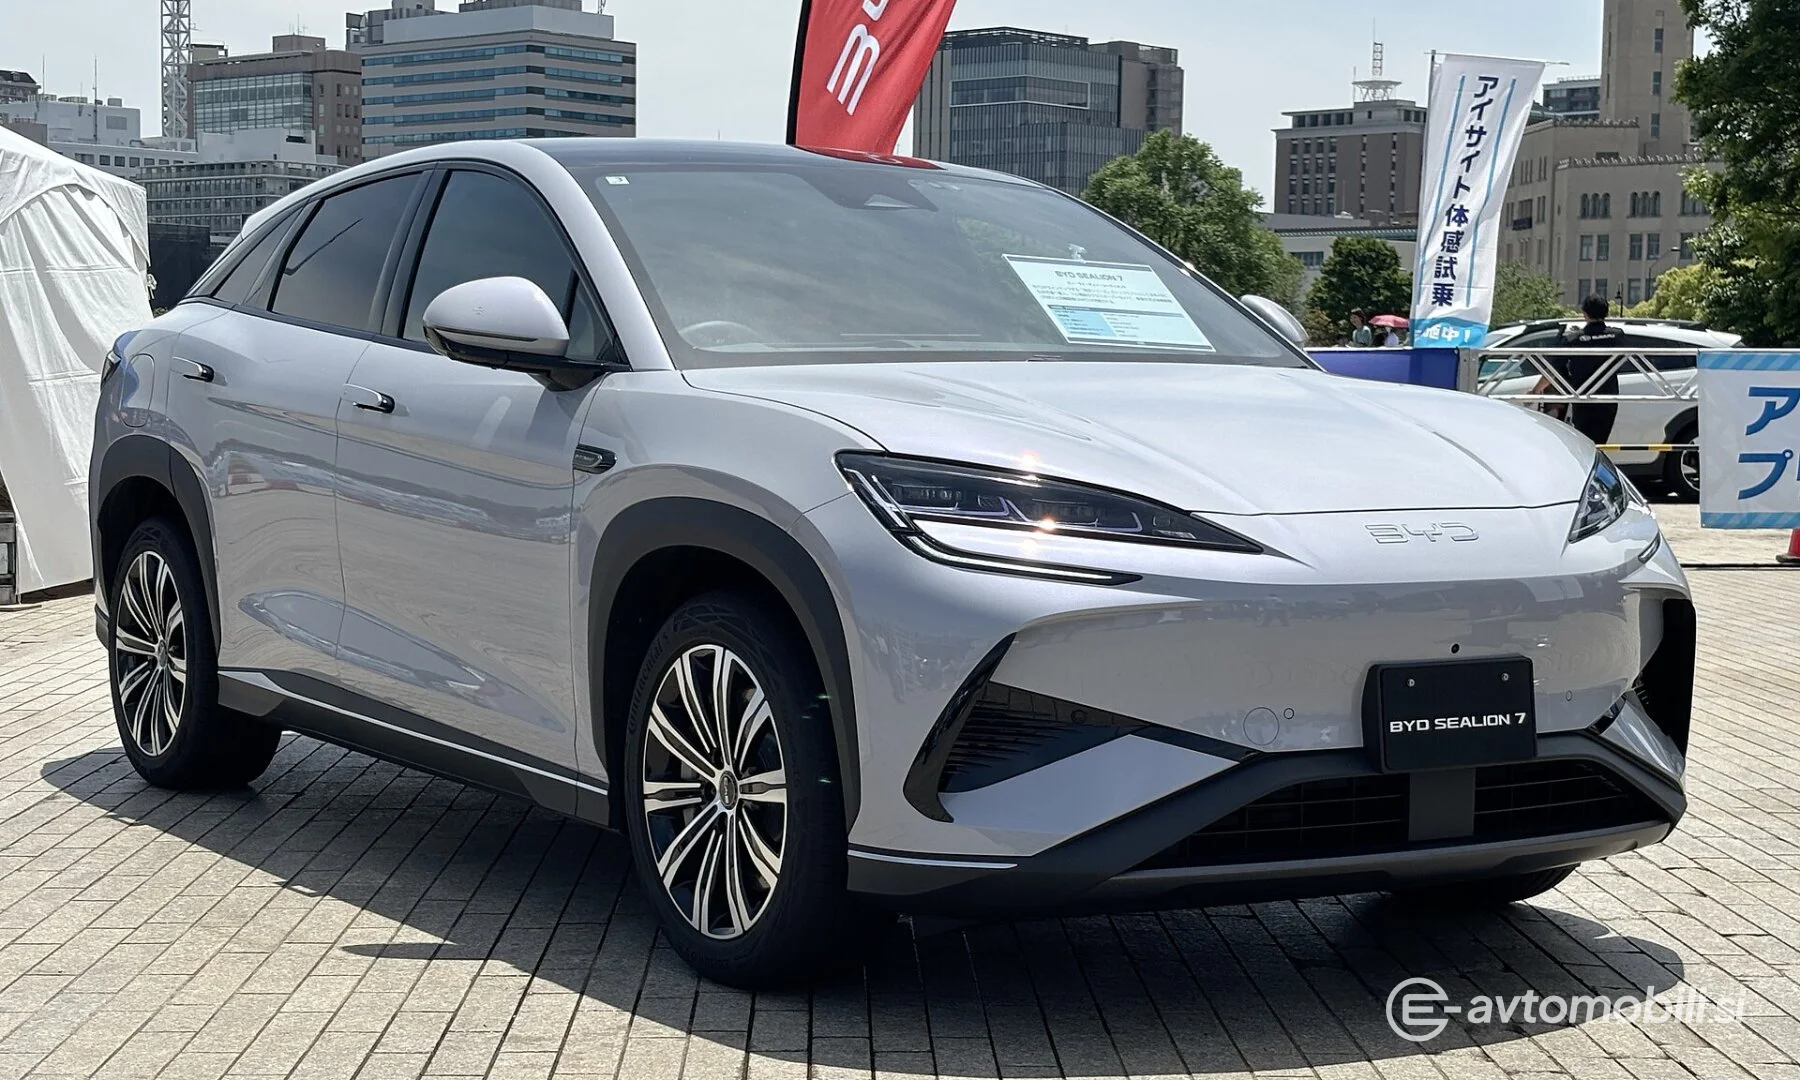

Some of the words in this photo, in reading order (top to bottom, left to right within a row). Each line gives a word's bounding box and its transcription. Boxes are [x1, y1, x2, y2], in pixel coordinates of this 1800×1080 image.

[1431, 75, 1499, 308] アイサイト体感試乗
[1414, 323, 1471, 343] 施中！
[1738, 449, 1800, 500] プ
[1364, 522, 1479, 544] BYD
[1389, 719, 1430, 733] BYD
[1434, 713, 1511, 730] SEALION
[1514, 712, 1526, 724] 7
